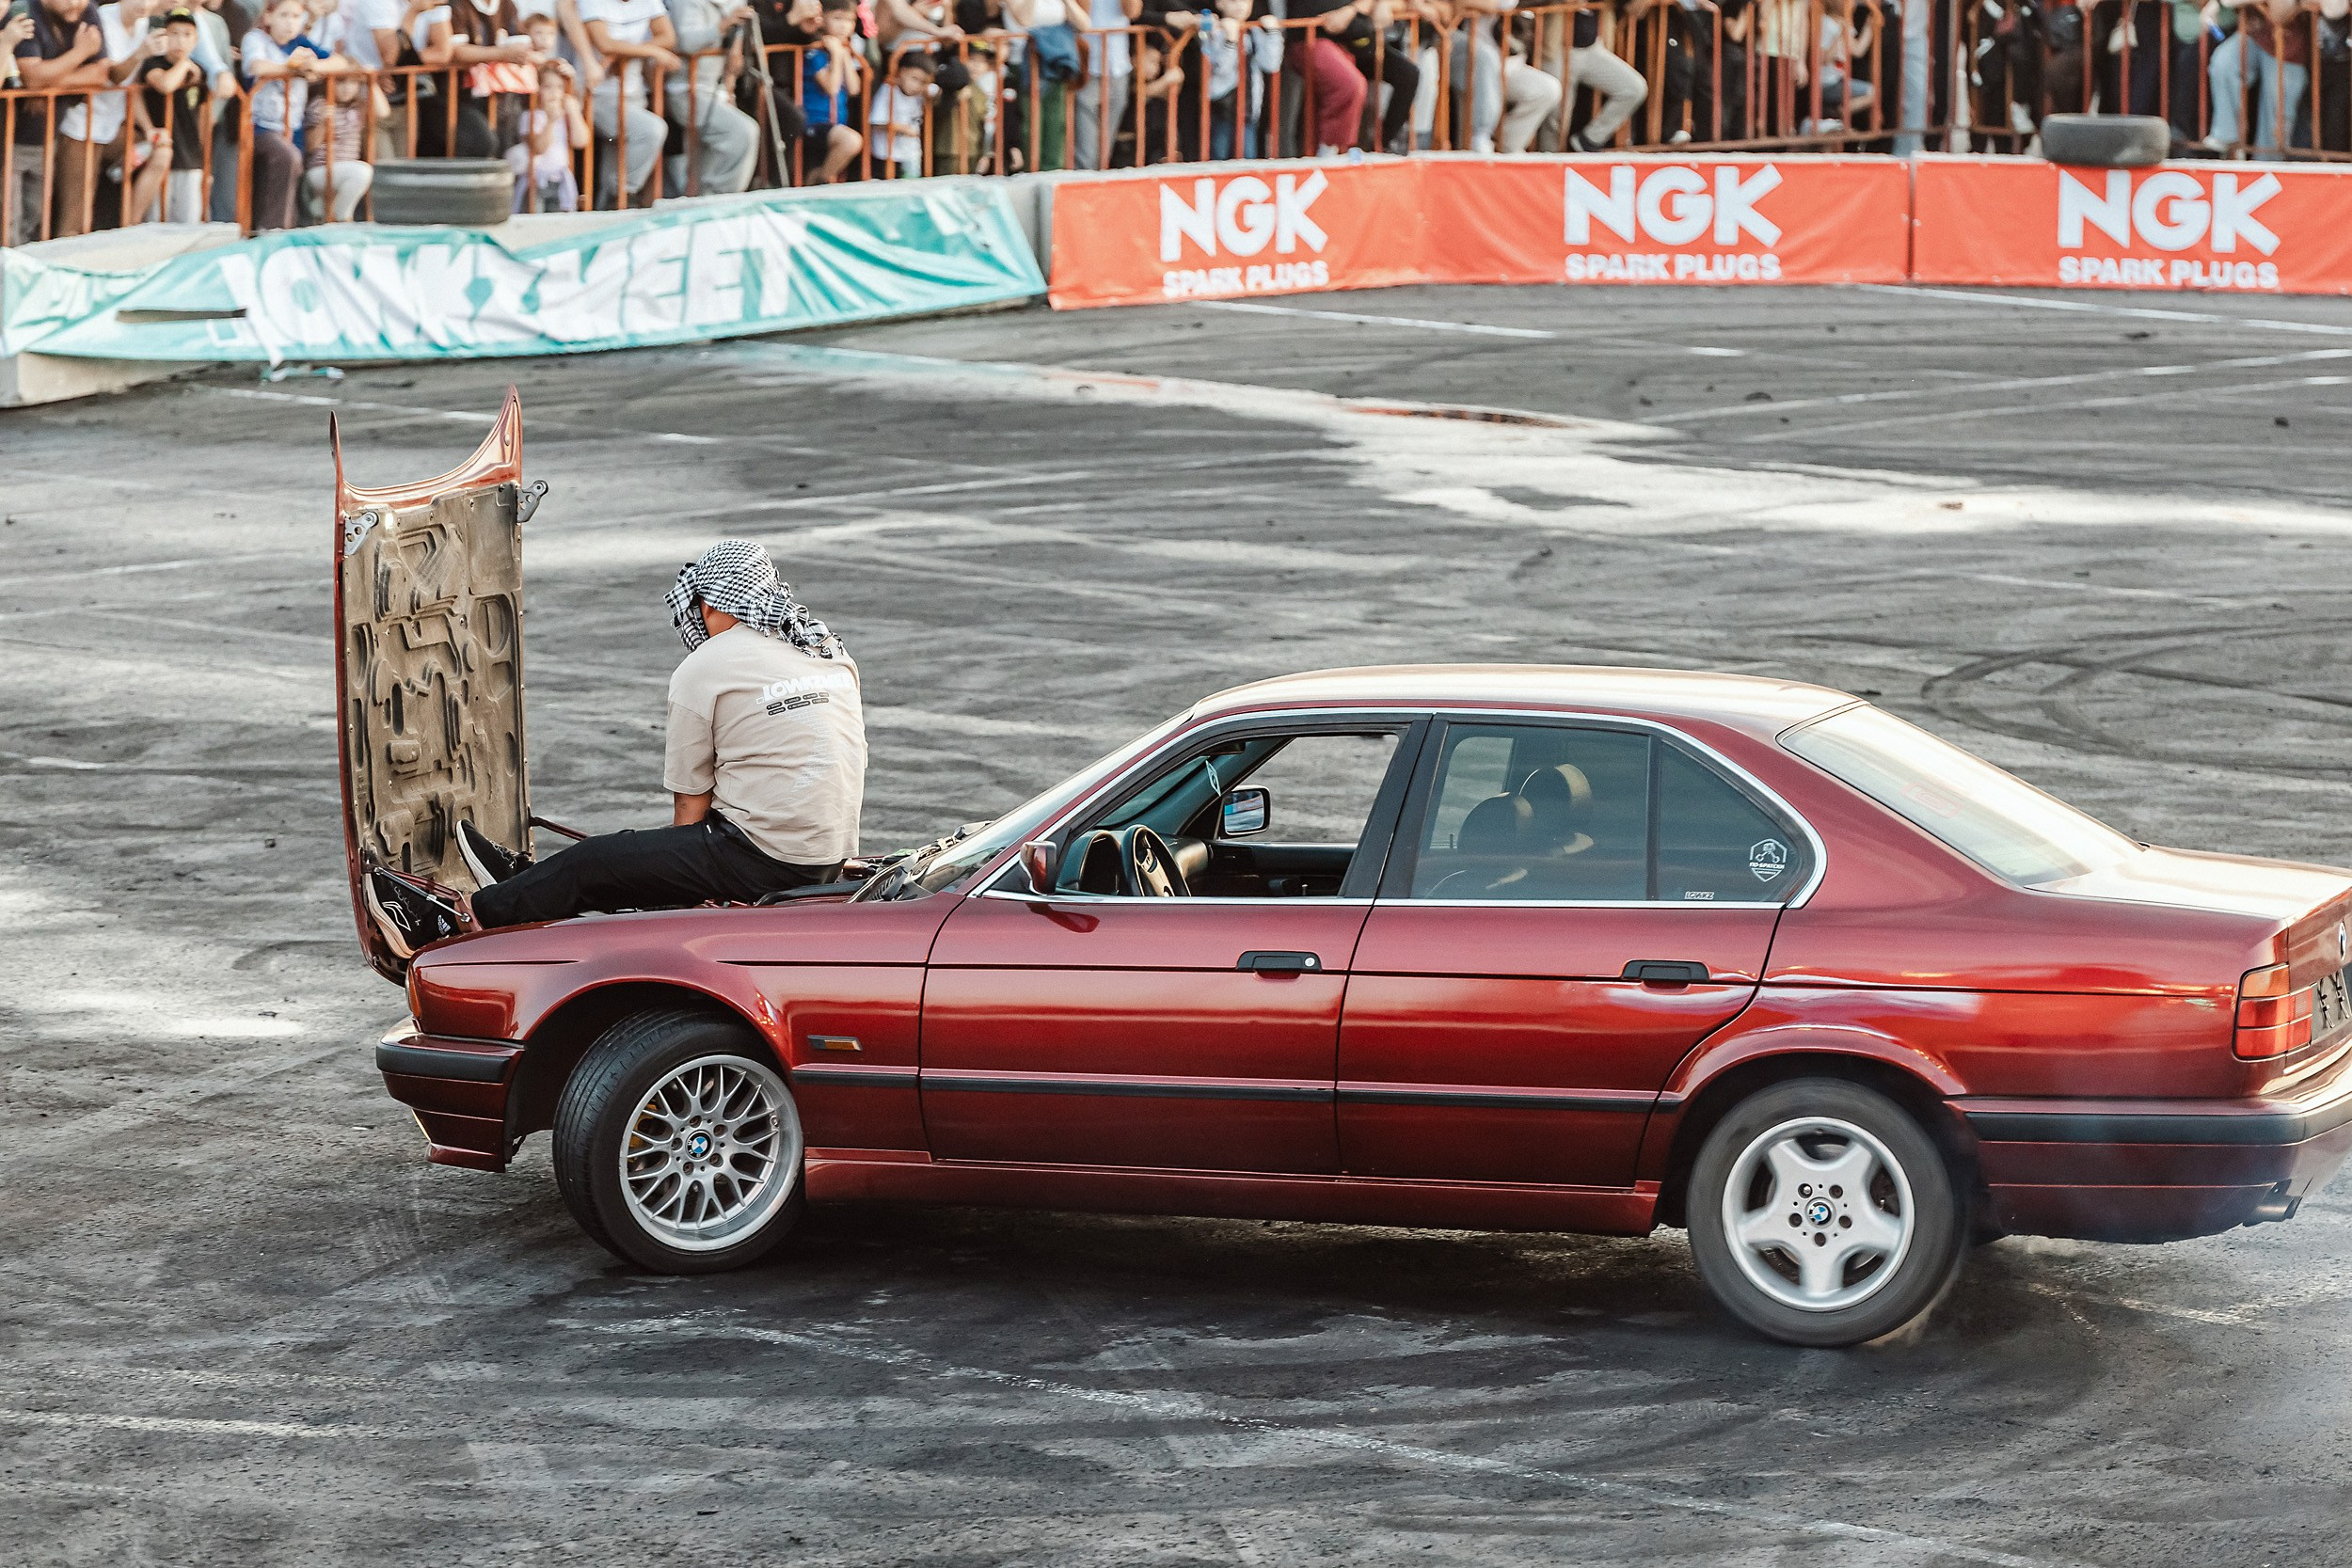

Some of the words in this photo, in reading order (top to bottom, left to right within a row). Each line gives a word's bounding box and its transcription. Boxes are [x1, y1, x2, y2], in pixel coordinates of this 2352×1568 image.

[1160, 168, 1328, 261] NGK
[1564, 164, 1783, 247] NGK
[2057, 168, 2283, 257] NGK
[1162, 265, 1243, 298] SPARK
[1246, 260, 1329, 291] PLUGS
[1565, 252, 1671, 280] SPARK
[1675, 252, 1783, 280] PLUGS
[2058, 255, 2165, 285] SPARK
[2169, 259, 2280, 289] PLUGS
